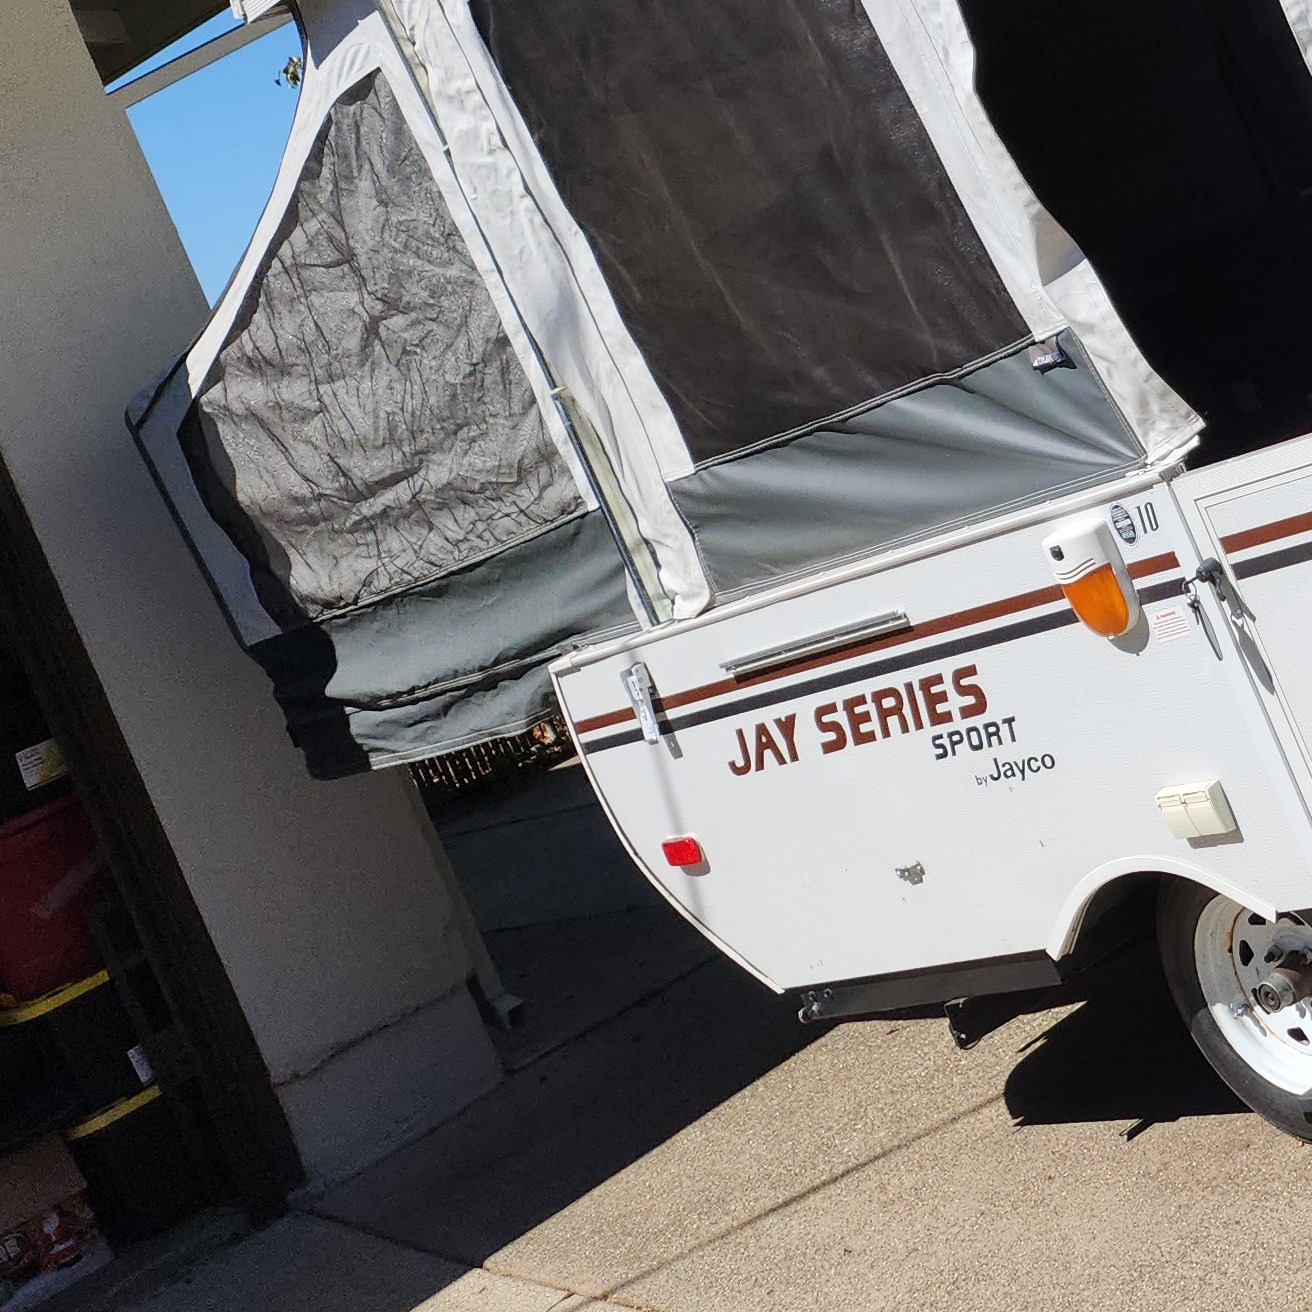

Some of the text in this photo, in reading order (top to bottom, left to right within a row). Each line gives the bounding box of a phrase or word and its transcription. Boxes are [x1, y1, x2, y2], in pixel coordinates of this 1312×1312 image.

[1135, 502, 1159, 534] 10
[728, 664, 987, 776] JAY SERIES
[931, 716, 1017, 761] SPORT
[975, 753, 1056, 787] by Jayco
